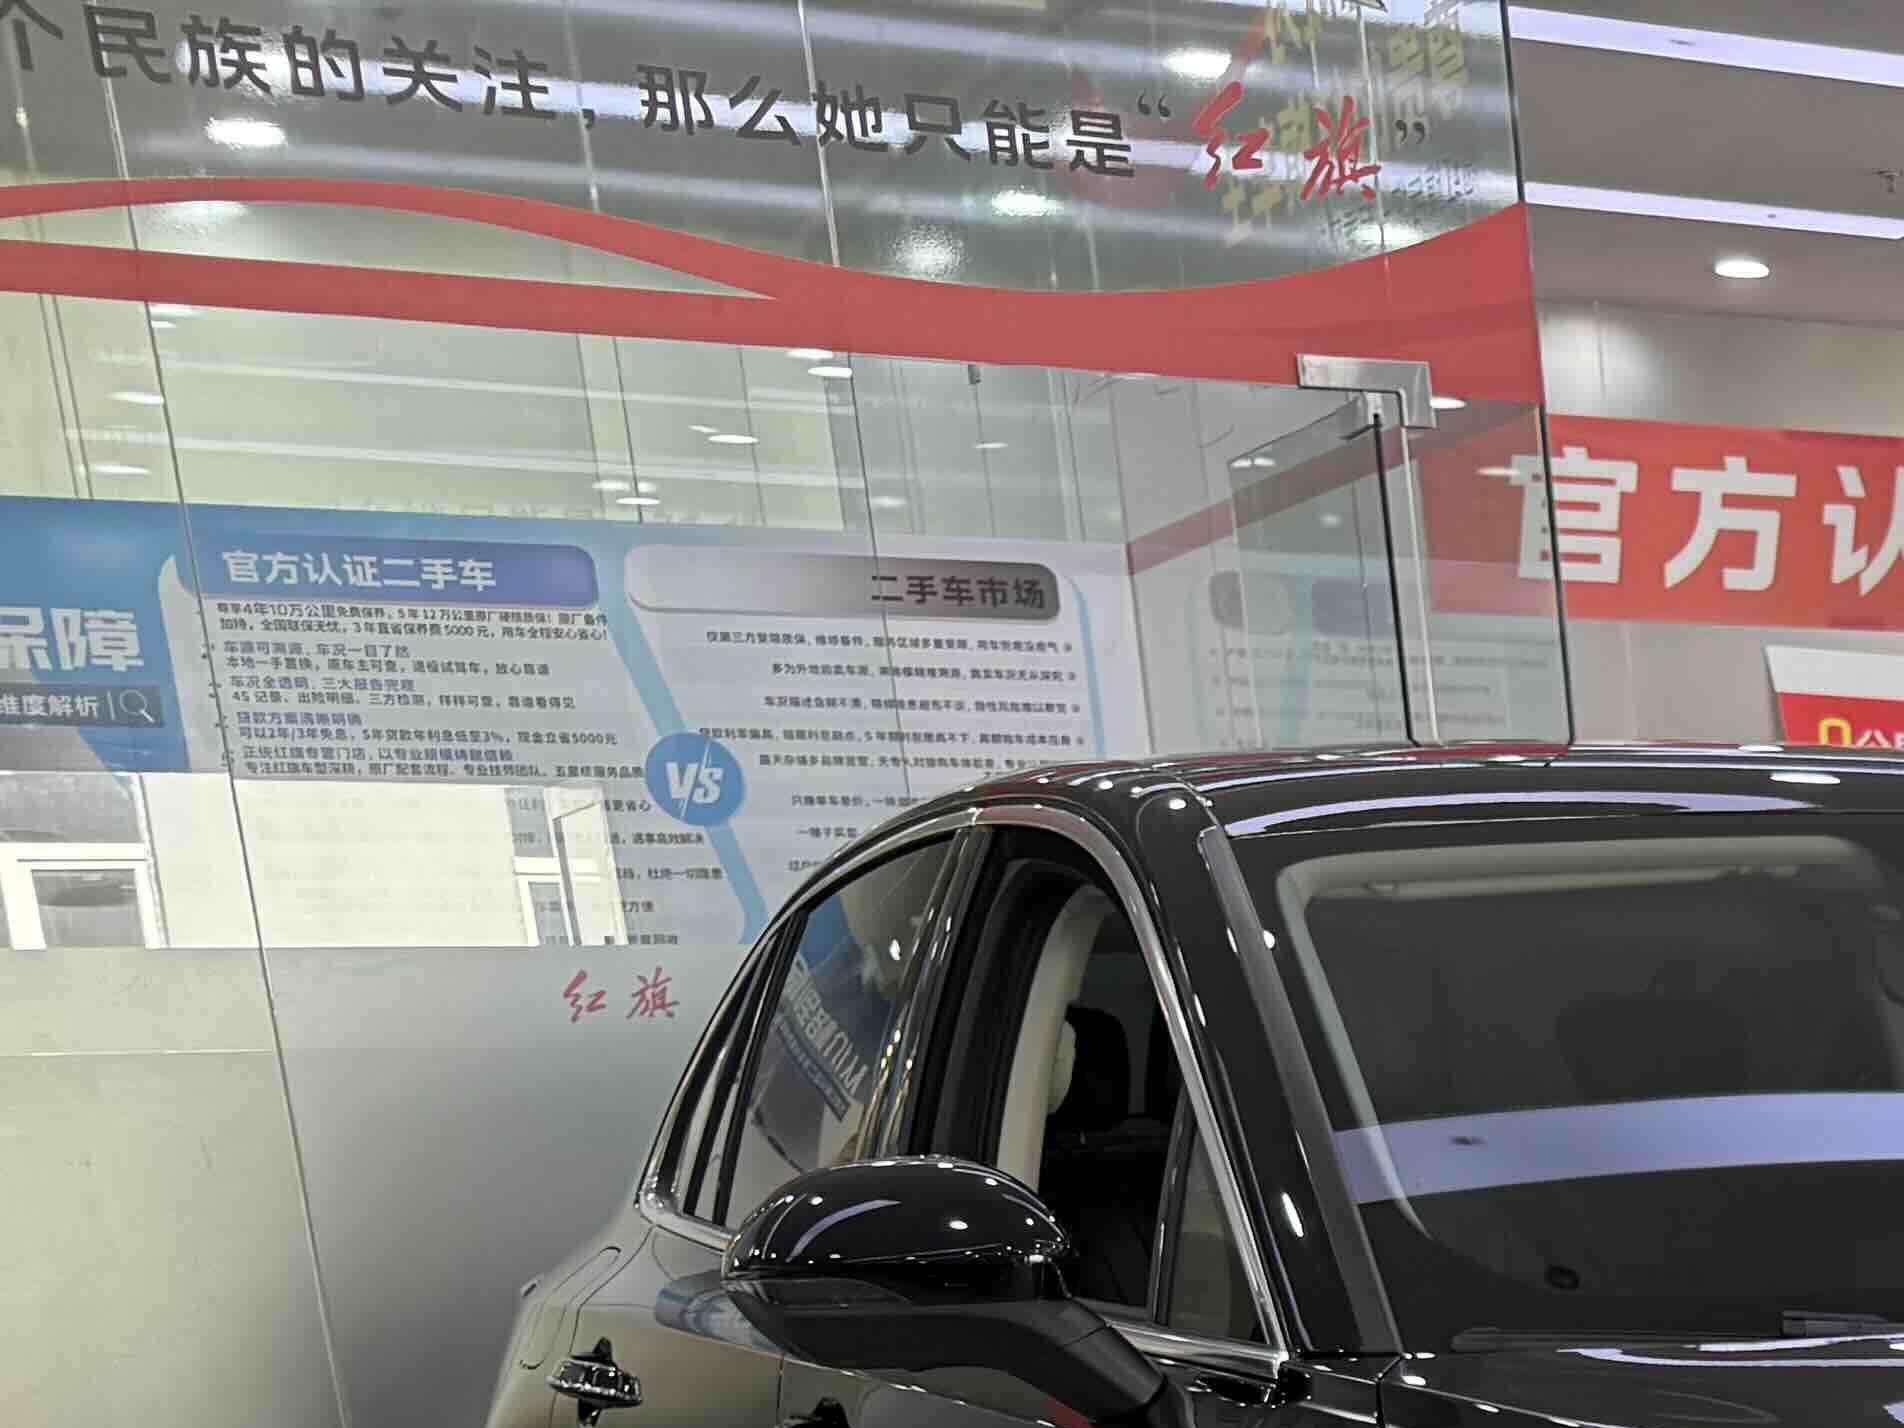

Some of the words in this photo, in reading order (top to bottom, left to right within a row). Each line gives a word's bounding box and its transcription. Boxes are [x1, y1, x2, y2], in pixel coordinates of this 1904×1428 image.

[222, 550, 497, 592] 官方认证二手车
[872, 575, 1045, 609] 二手车市场
[665, 762, 723, 805] VS
[562, 965, 681, 1024] 红旗
